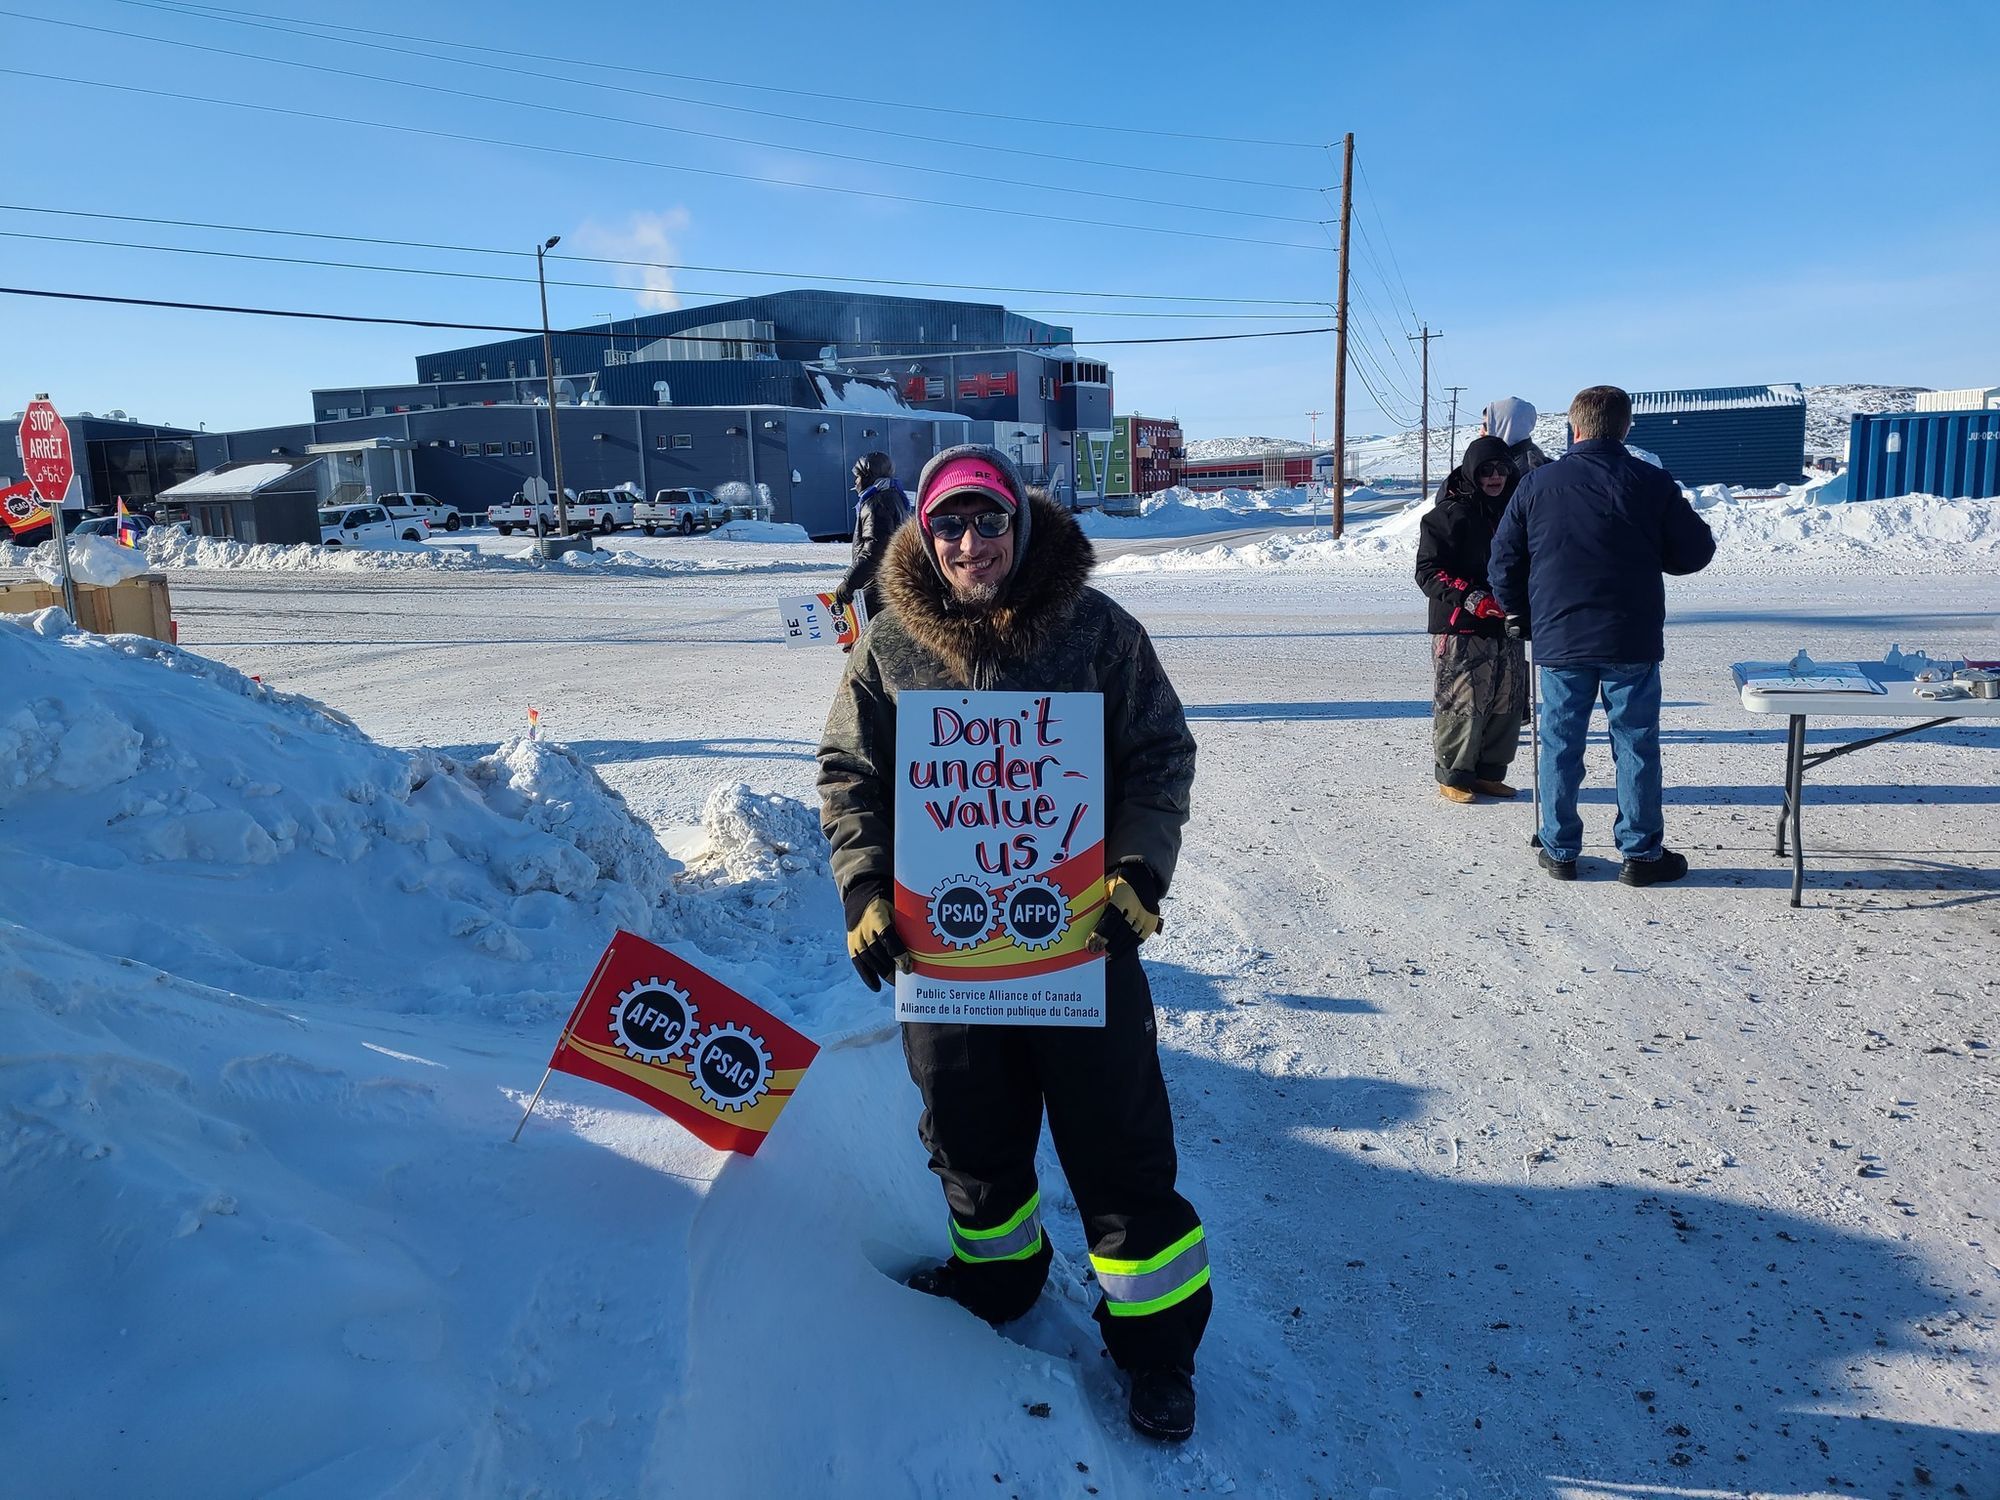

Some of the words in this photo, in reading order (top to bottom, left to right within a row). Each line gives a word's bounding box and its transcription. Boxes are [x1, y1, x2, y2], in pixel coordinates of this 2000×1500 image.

[30, 411, 54, 431] STOP
[30, 435, 62, 459] ARRÊT
[10, 501, 29, 513] PSAC
[787, 618, 802, 637] BE
[929, 697, 1063, 747] Don't
[909, 745, 1088, 792] under-
[925, 789, 1059, 832] value
[941, 903, 984, 923] PSAC
[1013, 904, 1057, 924] AFPC
[916, 988, 946, 999] Public
[949, 989, 986, 1000] Service
[989, 990, 1029, 1001] Alliance
[1031, 990, 1042, 1001] of
[1045, 991, 1082, 1002] Canada
[900, 1003, 936, 1014] Alliance
[938, 1003, 950, 1015] de
[952, 1004, 961, 1015] la
[963, 1005, 1004, 1016] Fonction
[1006, 1006, 1047, 1018] publique
[1049, 1006, 1061, 1017] du
[1064, 1007, 1099, 1018] Canada
[626, 1002, 682, 1042] AFPC
[704, 1045, 754, 1090] PSAC
